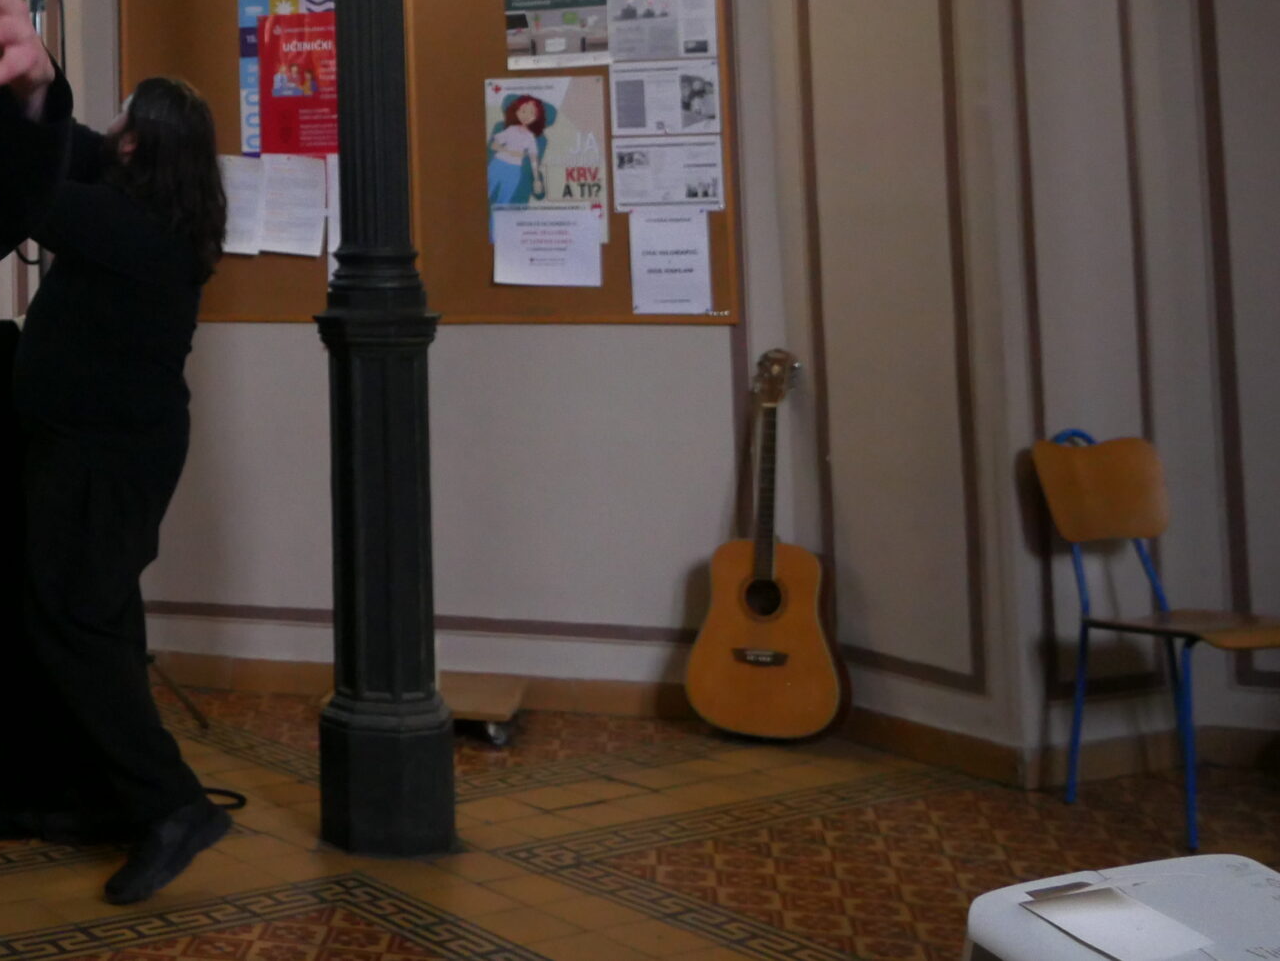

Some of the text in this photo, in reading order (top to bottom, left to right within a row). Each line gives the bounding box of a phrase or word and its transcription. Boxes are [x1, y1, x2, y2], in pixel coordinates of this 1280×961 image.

[568, 131, 599, 155] JA
[562, 182, 601, 198] A TI?
